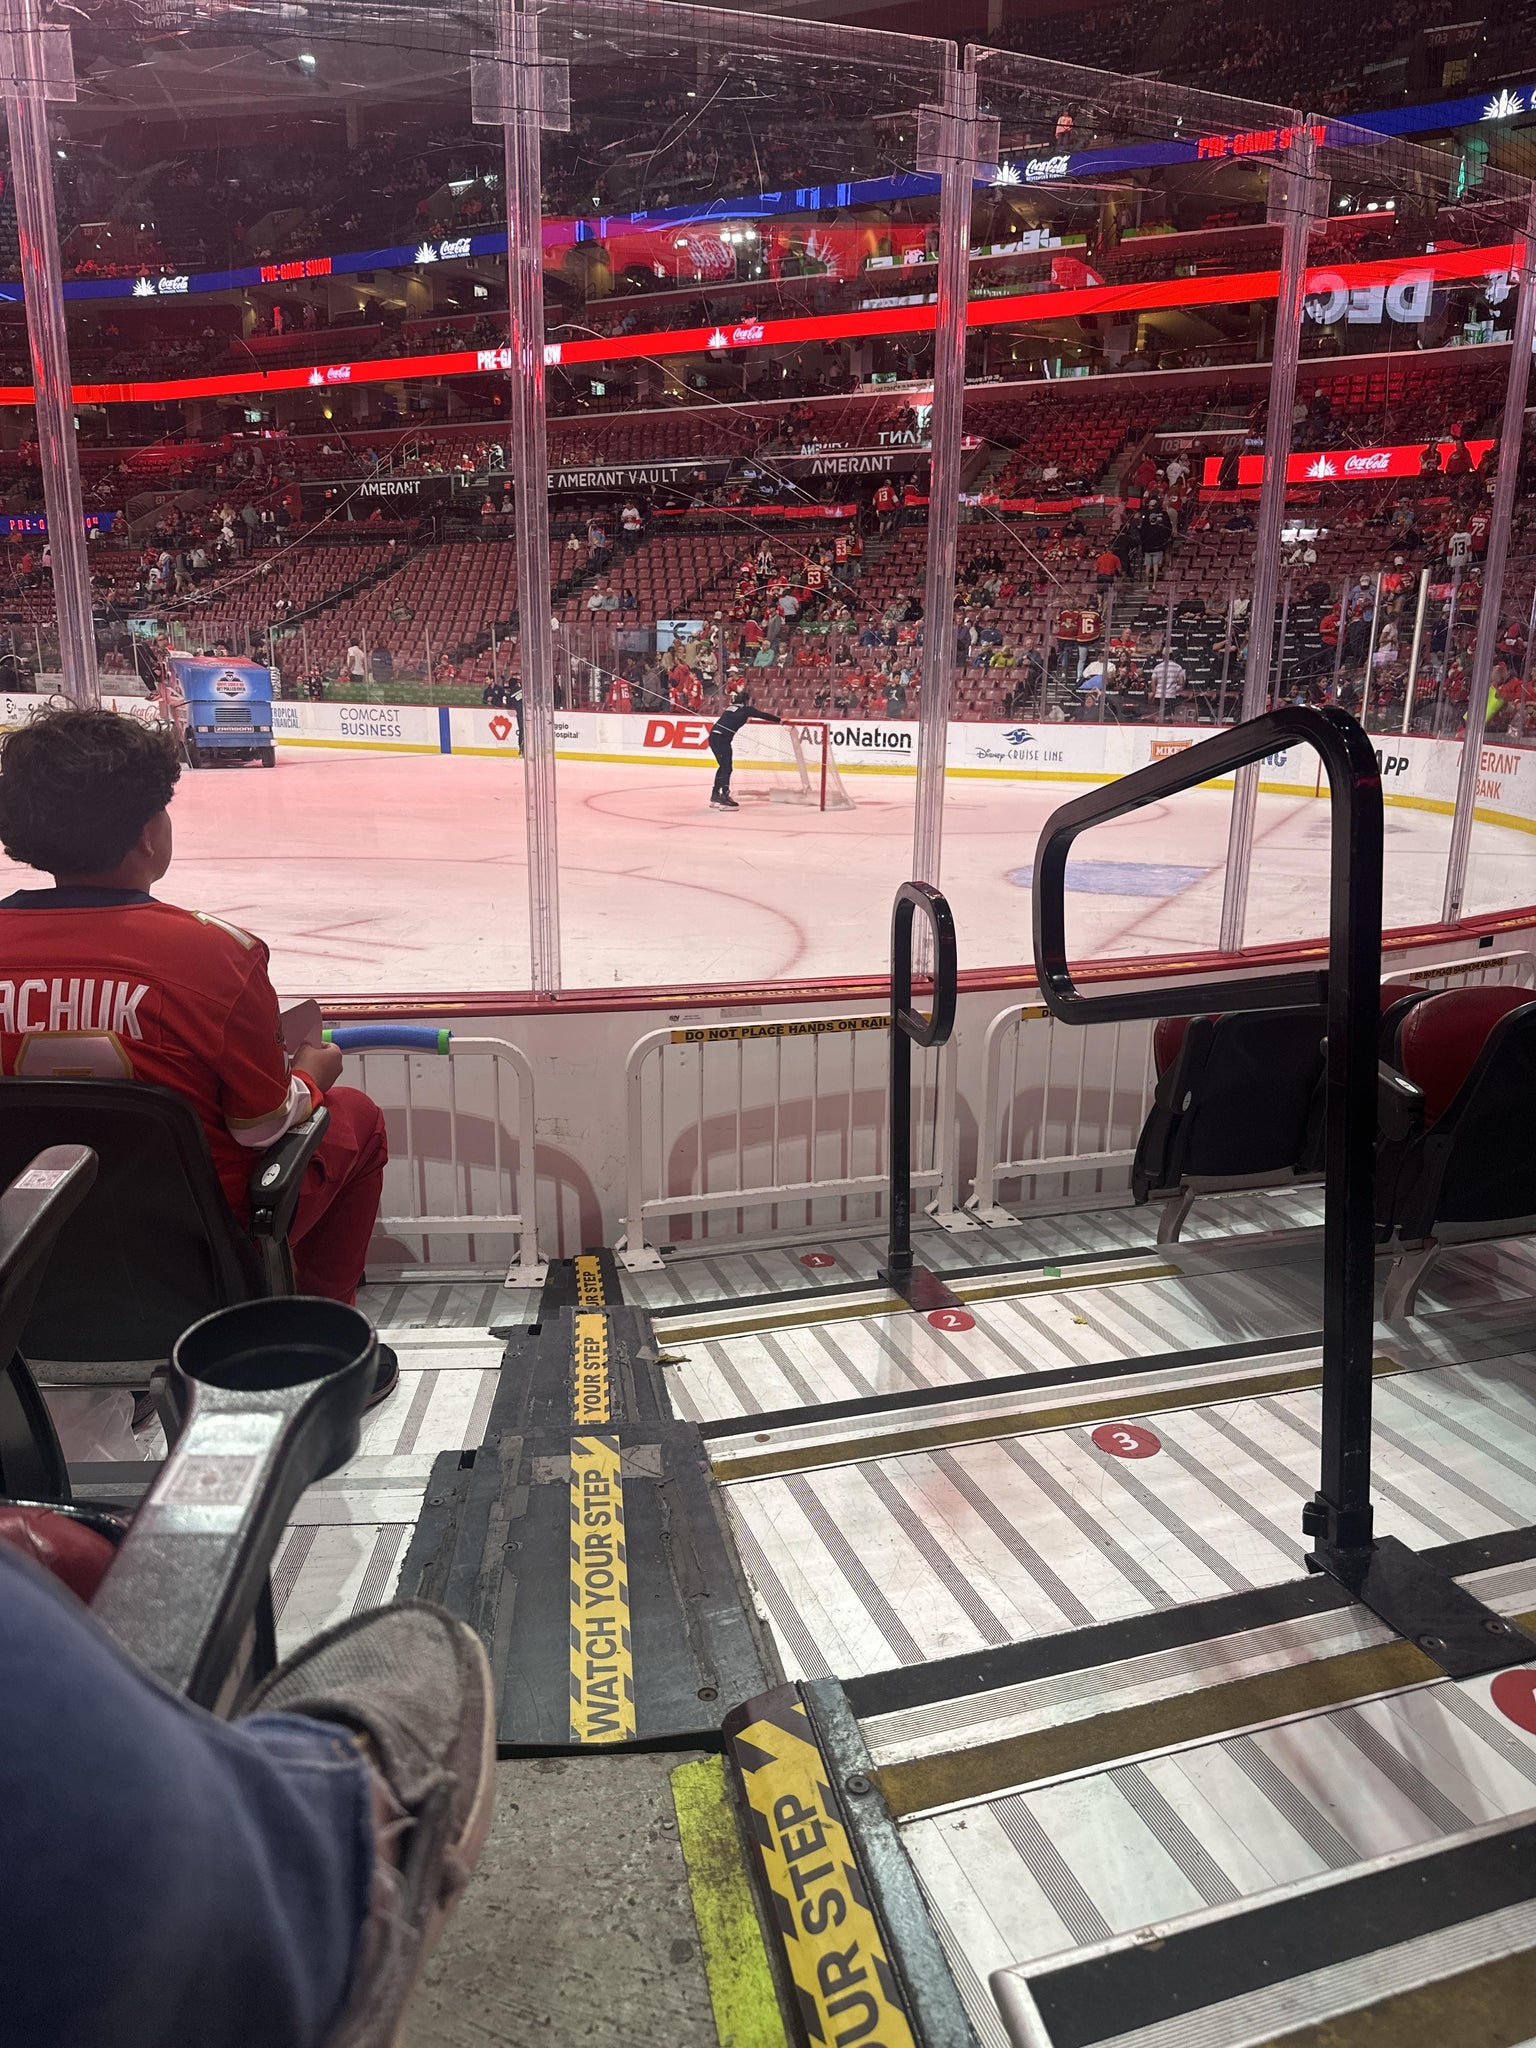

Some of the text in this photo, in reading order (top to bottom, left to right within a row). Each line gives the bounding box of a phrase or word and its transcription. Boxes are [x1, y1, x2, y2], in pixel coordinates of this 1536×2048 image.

[1198, 130, 1277, 159] PRE-GAME
[1025, 155, 1071, 177] Coca-Cola
[440, 237, 472, 256] Coca-Cola
[260, 257, 332, 283] PRE-GAME SHOW
[158, 275, 189, 290] Coca-Cola
[733, 326, 764, 341] Coca-Cola
[327, 366, 351, 379] Coca-Cola
[811, 455, 894, 475] AMERANT
[1344, 452, 1392, 471] Coca-Cola
[558, 471, 624, 488] AMERANT
[629, 468, 678, 484] VAULT
[360, 480, 421, 497] AMERANT
[878, 490, 888, 502] 13
[1470, 522, 1485, 537] 72
[836, 544, 847, 556] 63
[1454, 541, 1466, 556] 13
[807, 571, 821, 585] 63
[1081, 618, 1094, 634] 16
[130, 704, 160, 721] Coca-Cola
[339, 707, 400, 722] COMCAST
[341, 722, 402, 737] BUSINESS
[554, 731, 579, 740] ospital
[975, 747, 1064, 762] Disney CRUISE LINE
[685, 1031, 705, 1041] DO
[708, 1029, 737, 1039] NOT
[741, 1026, 785, 1038] PLACE
[788, 1022, 834, 1034] HANDS
[838, 1020, 857, 1031] ON
[811, 1256, 825, 1266] 1
[583, 1271, 597, 1294] STEP
[943, 1314, 961, 1327] 2
[583, 1337, 602, 1416] YOUR STEP
[1112, 1431, 1139, 1451] 3
[586, 1468, 619, 1738] WATCH YOUR STEP
[773, 1794, 848, 1936] STEP
